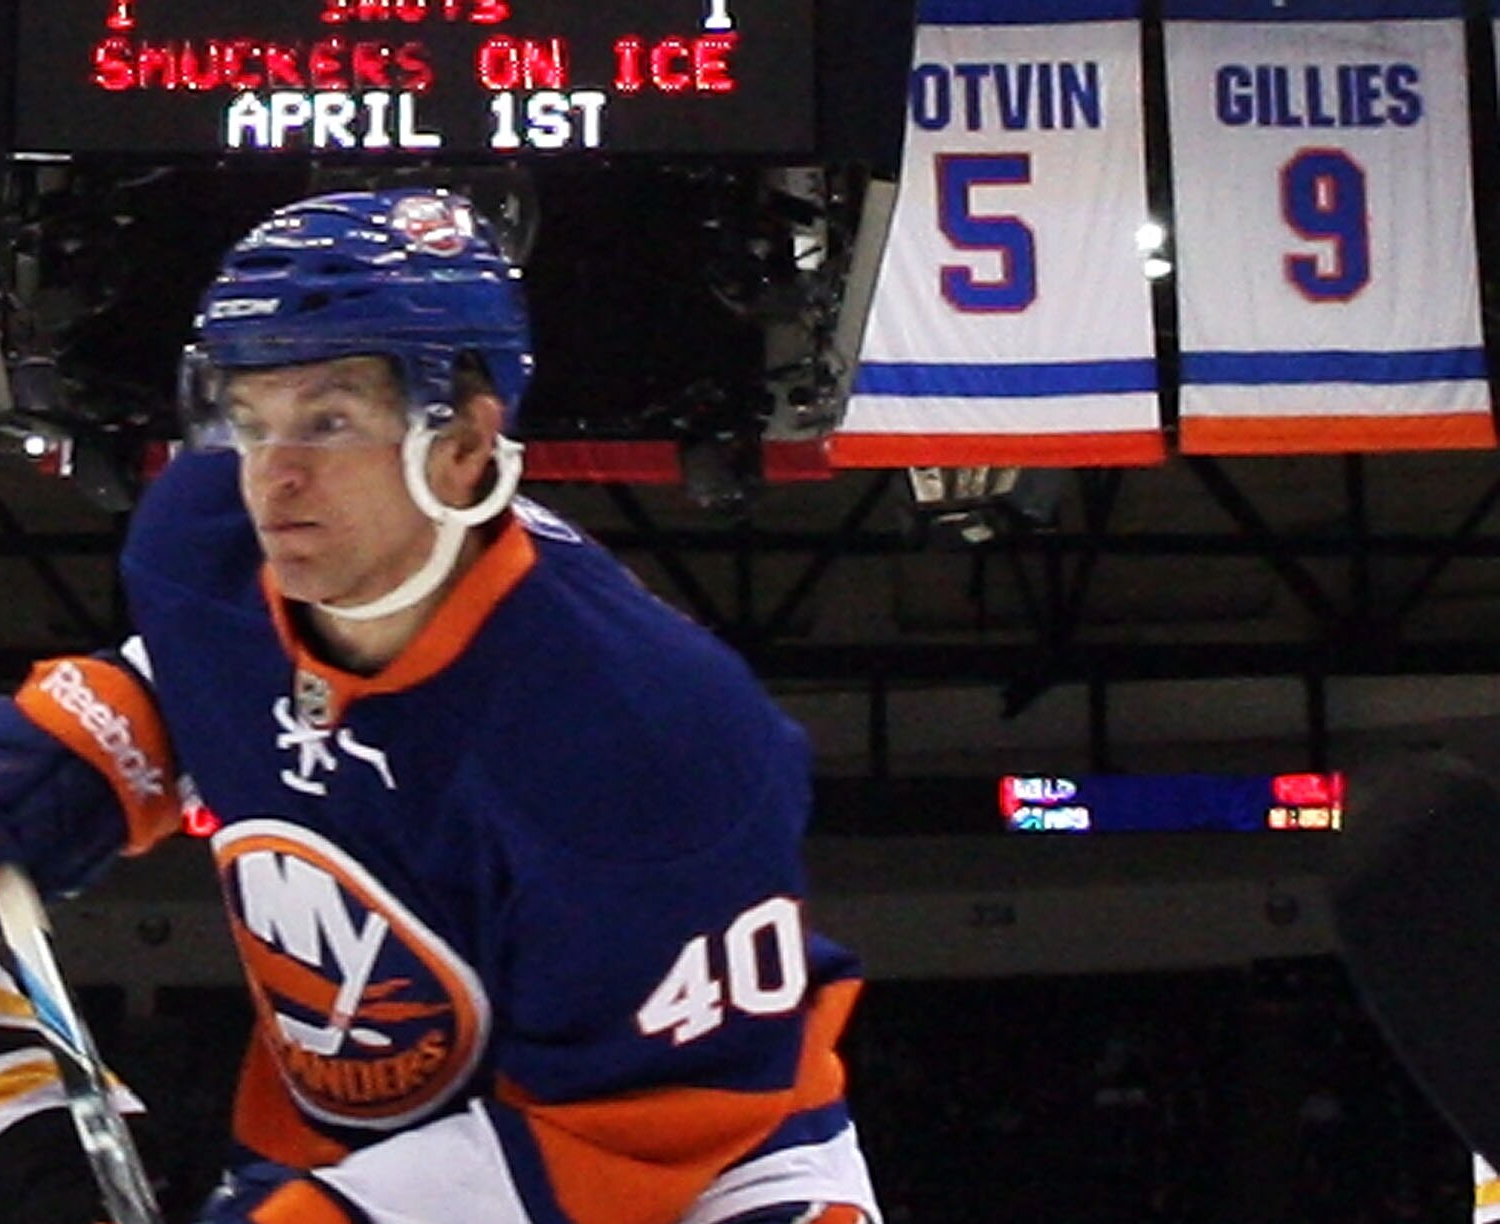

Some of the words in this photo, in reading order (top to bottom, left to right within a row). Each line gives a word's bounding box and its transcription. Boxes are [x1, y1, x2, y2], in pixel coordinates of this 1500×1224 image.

[90, 40, 433, 90] SMUCKERS
[477, 39, 570, 90] ON
[613, 38, 739, 90] ICE
[227, 92, 442, 149] APRIL
[490, 92, 607, 149] 1ST
[1214, 63, 1424, 127] GILLIES
[934, 152, 1038, 314] 5
[1279, 146, 1372, 302] 9
[40, 660, 165, 799] Reebok
[636, 896, 809, 1046] 40
